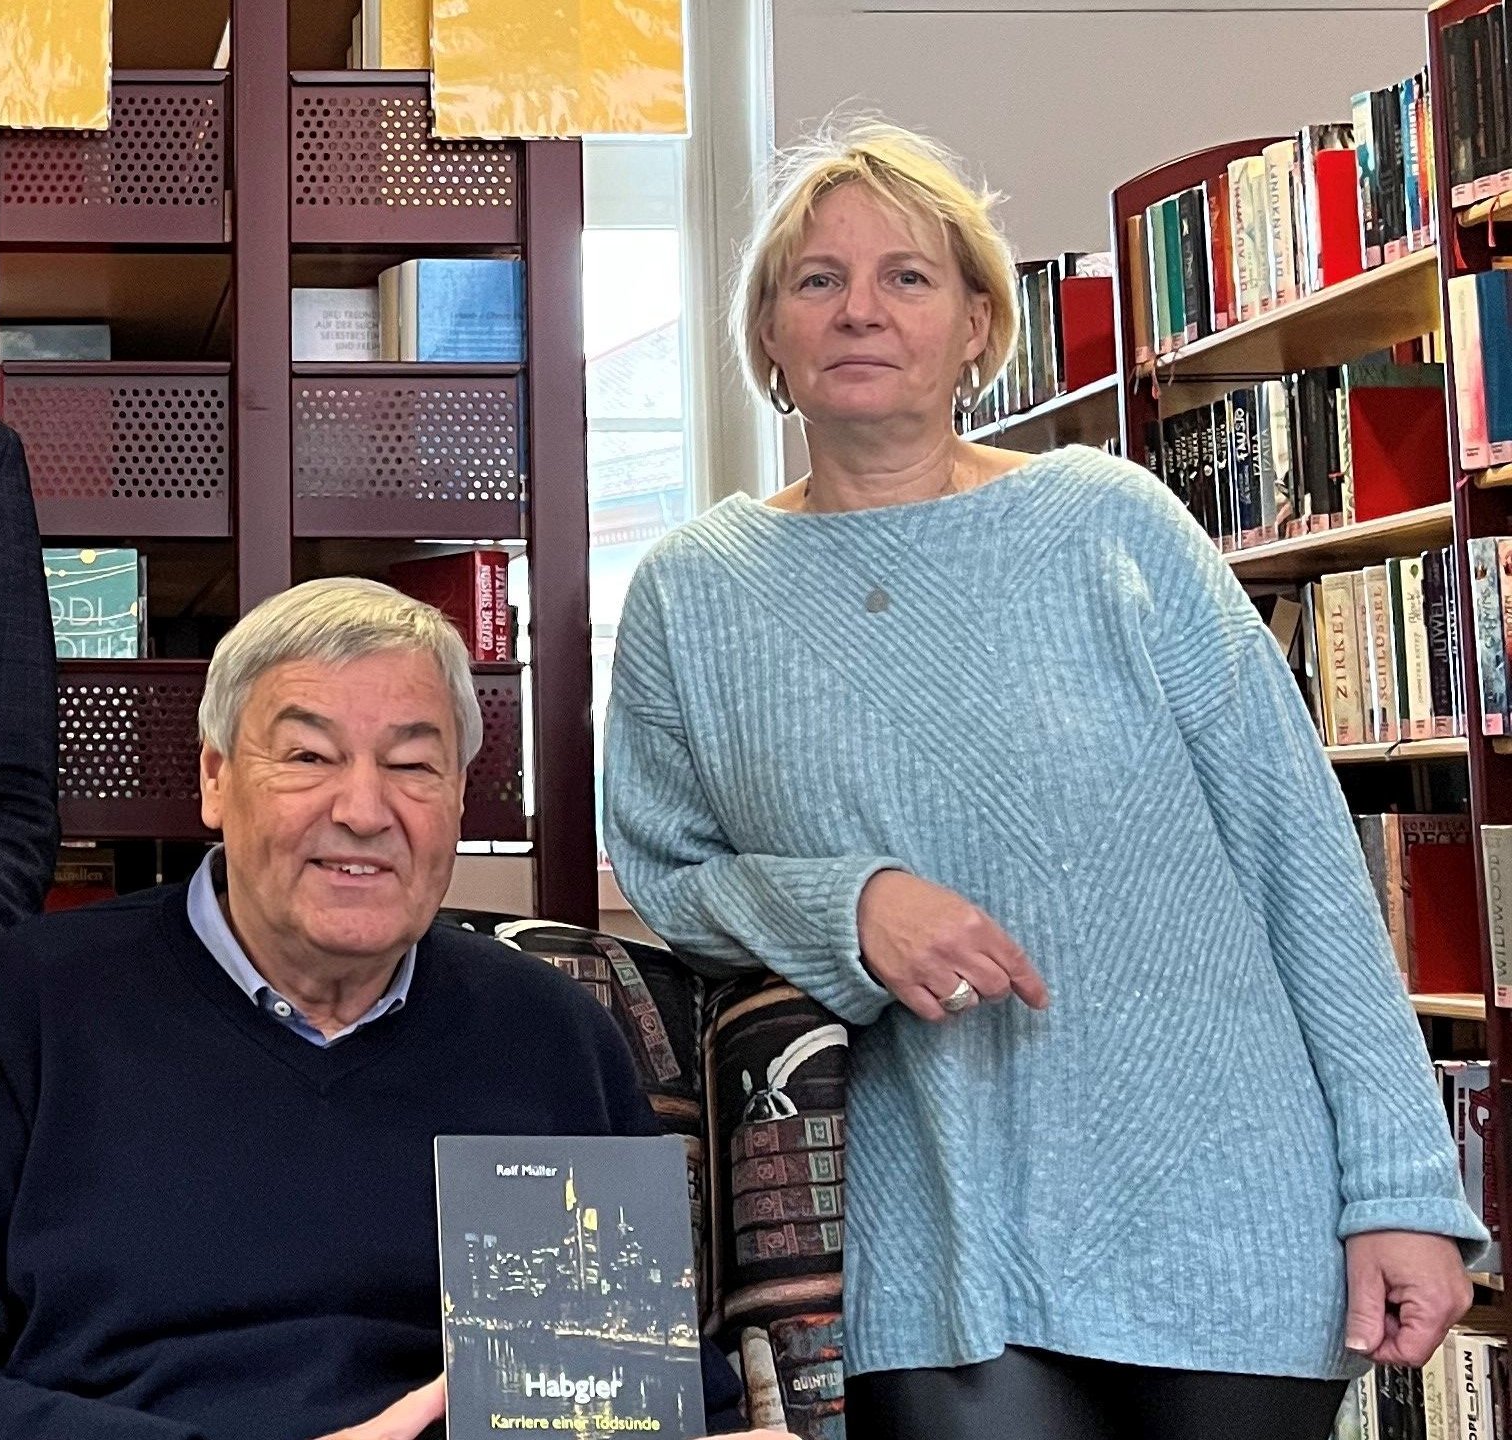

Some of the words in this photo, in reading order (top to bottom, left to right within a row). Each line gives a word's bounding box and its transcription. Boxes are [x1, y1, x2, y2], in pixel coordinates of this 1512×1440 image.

[1331, 604, 1349, 699] ZIRKEL
[1430, 595, 1449, 663] JUWEL
[1488, 855, 1508, 978] WILDWOOD
[495, 1164, 519, 1177] Rolf
[521, 1164, 558, 1177] Müller
[525, 1371, 623, 1404] Habgier
[491, 1413, 550, 1430] Karriere
[552, 1414, 588, 1430] einer
[593, 1413, 661, 1431] Todsünde
